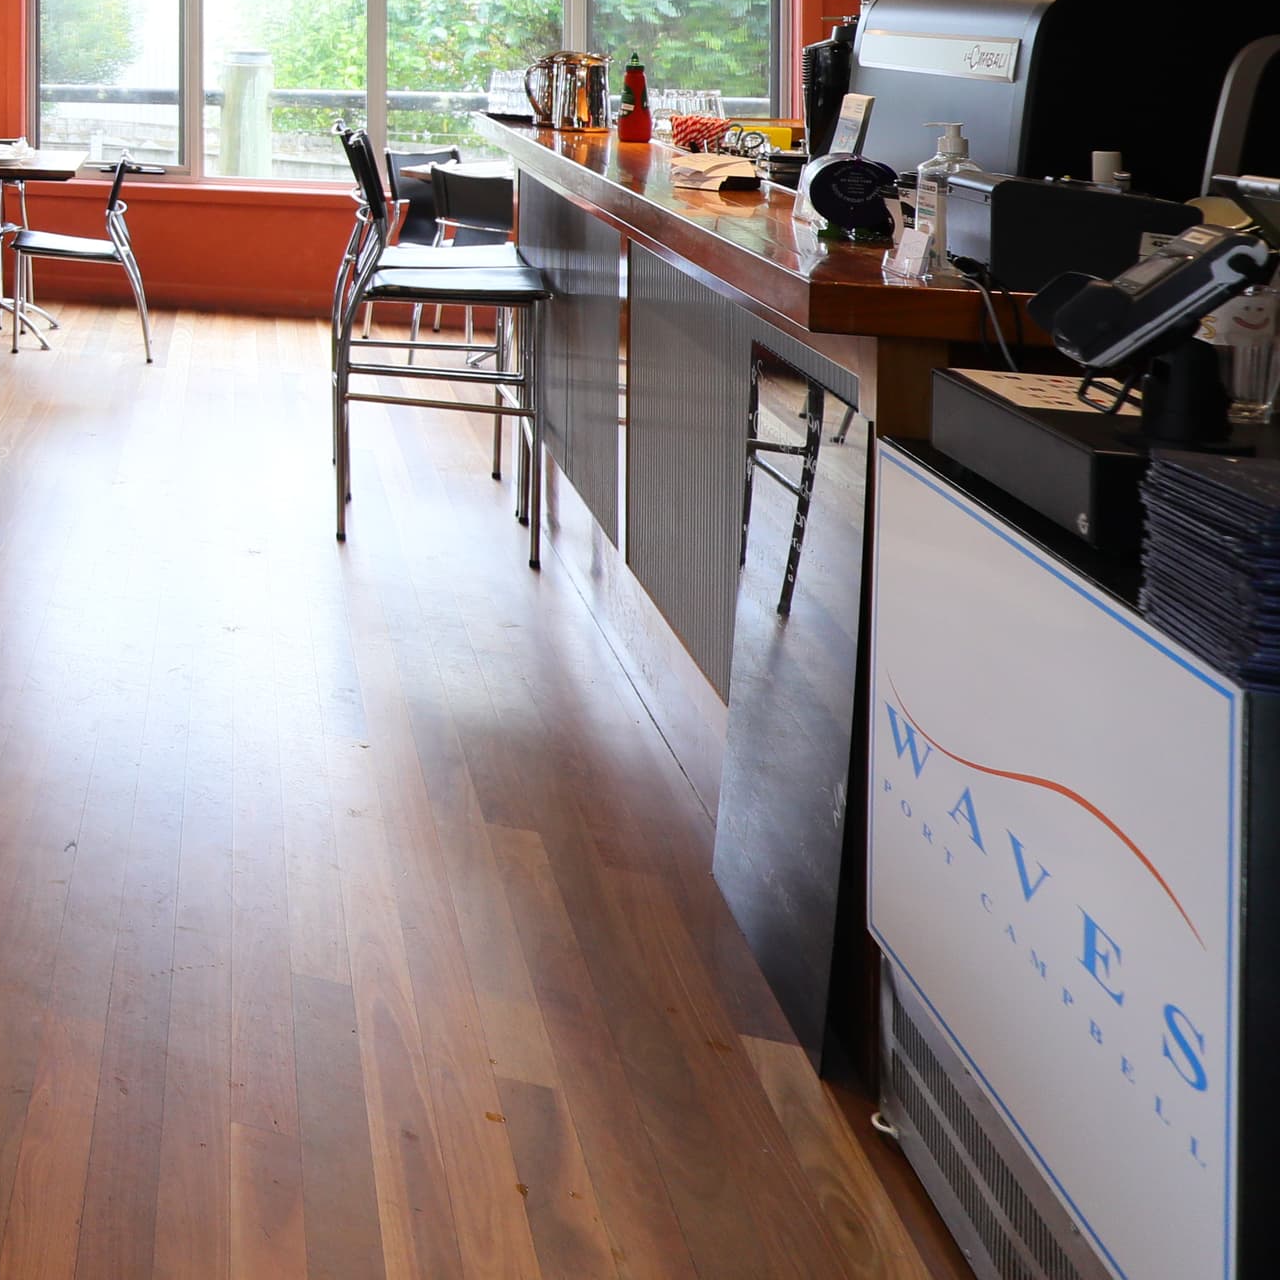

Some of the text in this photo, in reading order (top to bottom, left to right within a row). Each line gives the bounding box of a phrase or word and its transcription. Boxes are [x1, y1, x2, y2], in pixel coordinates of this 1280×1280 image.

[883, 779, 1208, 1169] PORT CAMPBELL
[884, 699, 1208, 1092] WAVES
